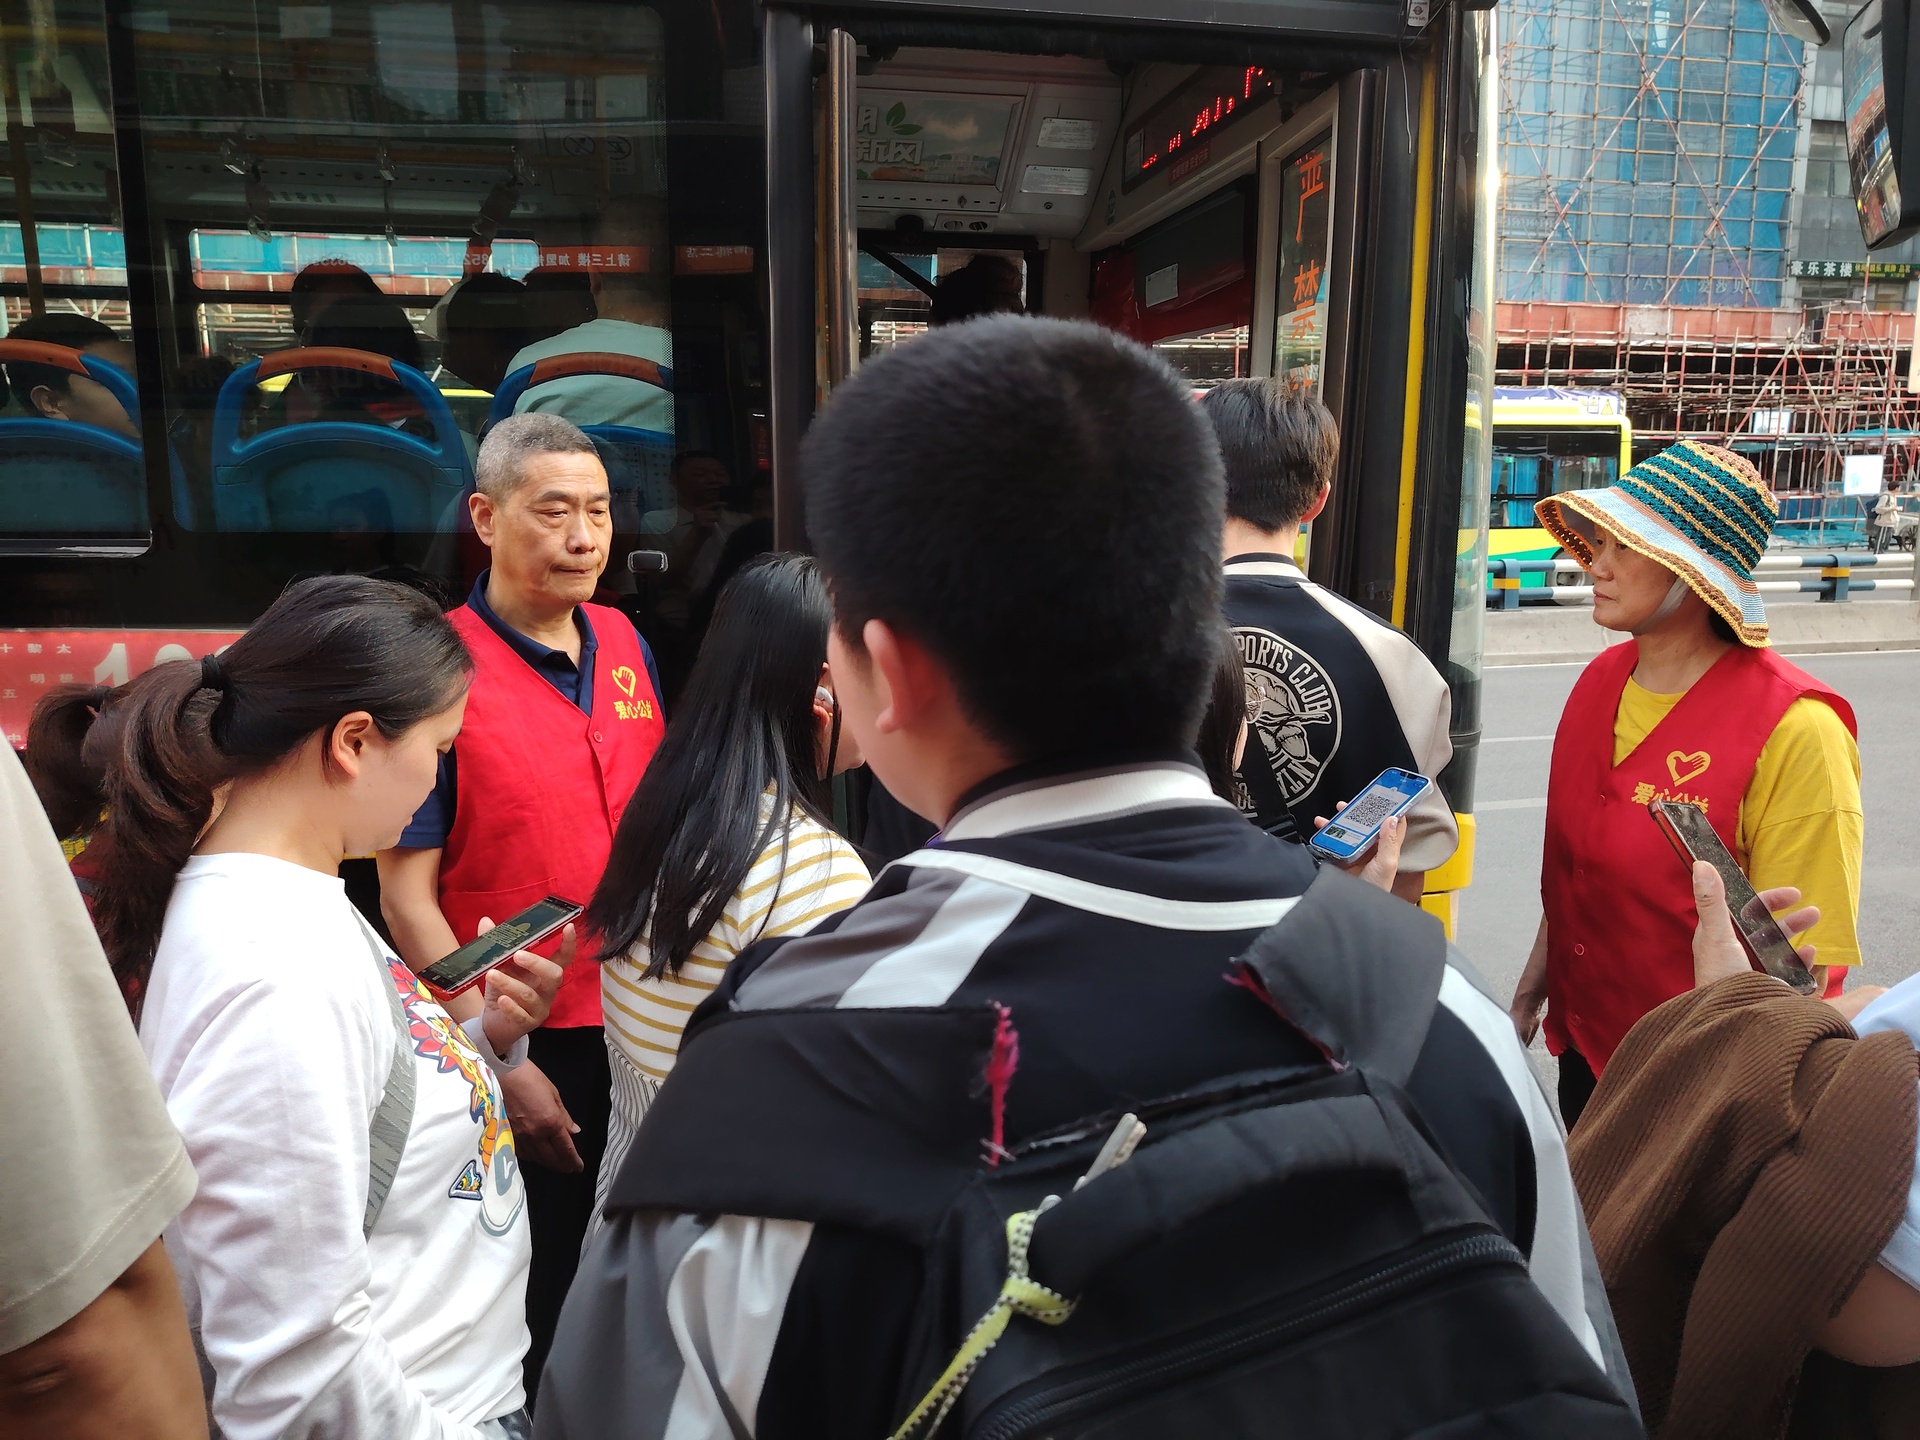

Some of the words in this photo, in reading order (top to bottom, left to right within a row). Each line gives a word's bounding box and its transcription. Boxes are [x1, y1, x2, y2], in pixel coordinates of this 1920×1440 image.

[1791, 260, 1853, 277] 豪乐茶楼
[1233, 635, 1293, 674] PORTS
[1288, 662, 1333, 713] CLUB
[613, 699, 653, 720] 爱心公益
